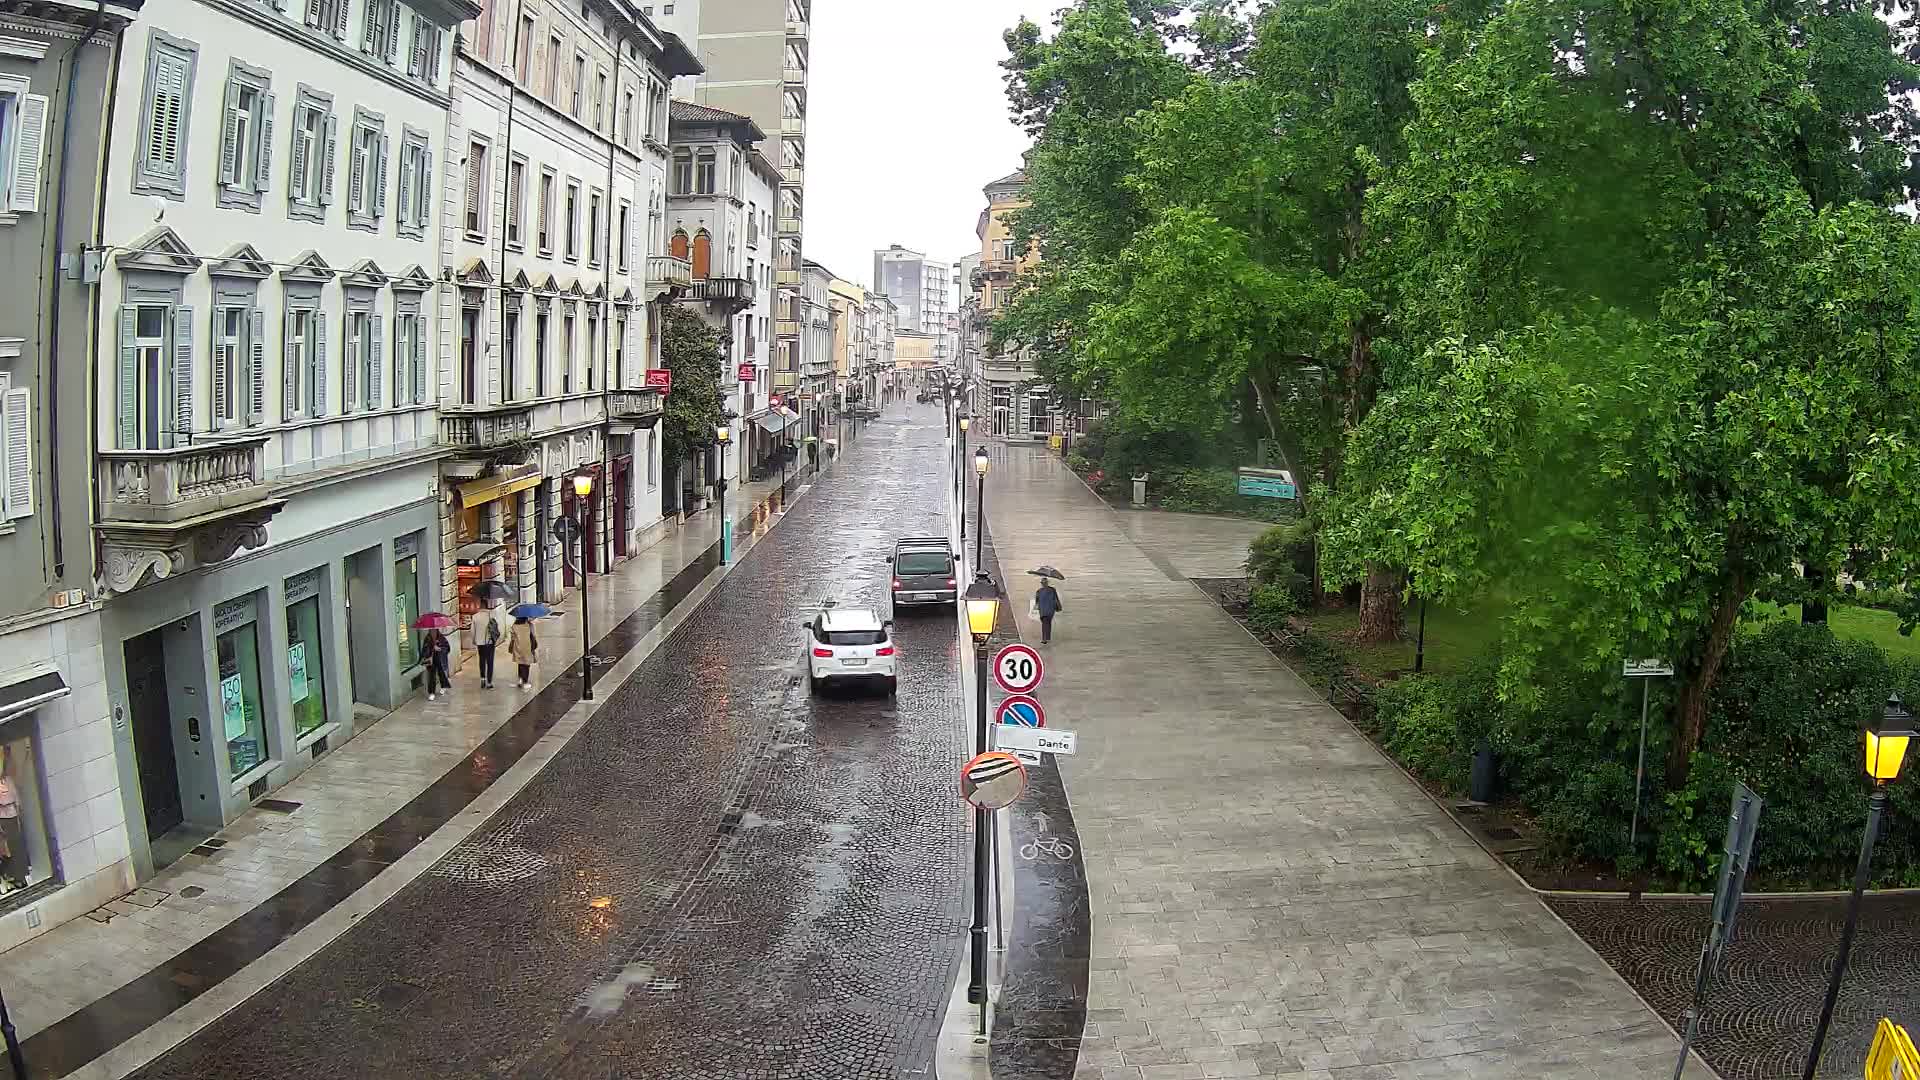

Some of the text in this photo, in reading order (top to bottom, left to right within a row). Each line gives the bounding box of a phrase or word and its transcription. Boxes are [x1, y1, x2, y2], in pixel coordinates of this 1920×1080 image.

[1005, 658, 1033, 680] 30
[222, 678, 240, 701] 130
[1038, 738, 1069, 750] Dante
